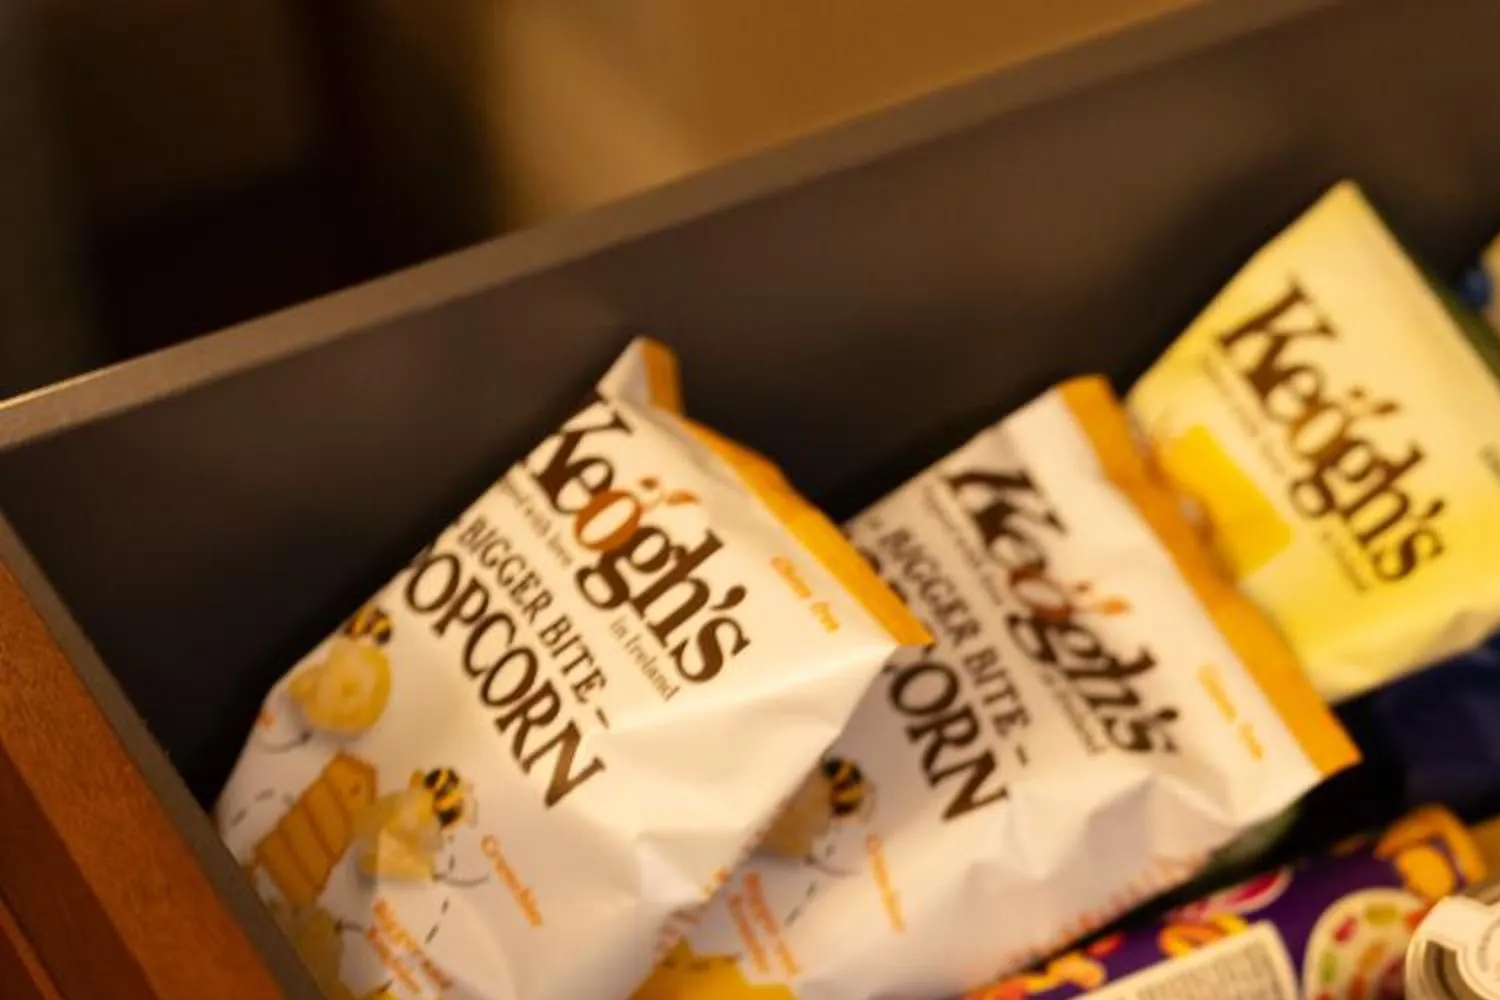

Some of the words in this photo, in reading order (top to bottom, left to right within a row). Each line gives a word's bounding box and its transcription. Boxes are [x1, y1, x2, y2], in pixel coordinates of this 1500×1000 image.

[528, 404, 750, 685] Keogh's
[1218, 276, 1446, 582] Keogh's
[404, 542, 606, 808] OPCORN
[457, 515, 554, 626] BIGGER
[538, 612, 607, 704] BITE
[625, 632, 681, 702] Ireland
[880, 528, 981, 648] BIGGER
[962, 648, 1031, 737] BITE
[944, 466, 1182, 756] Keogh's
